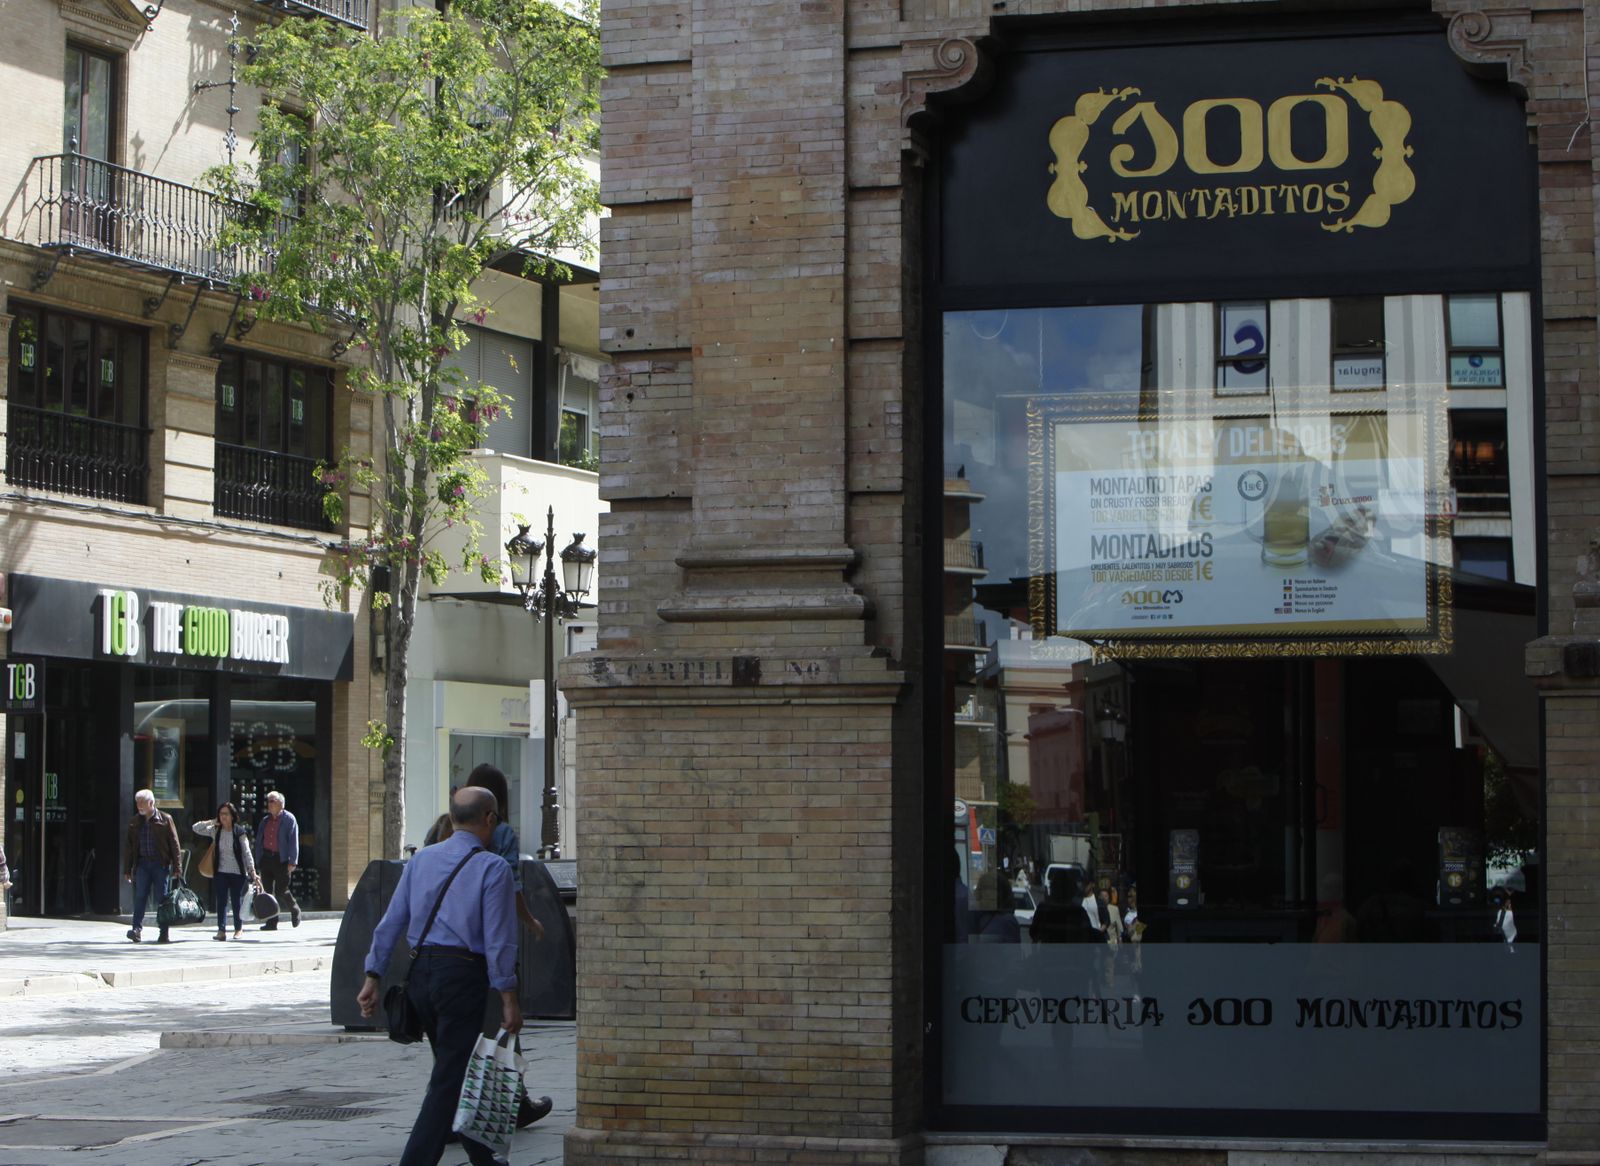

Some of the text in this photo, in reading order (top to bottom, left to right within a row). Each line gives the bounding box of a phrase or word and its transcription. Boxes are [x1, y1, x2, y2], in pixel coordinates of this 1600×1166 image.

[1109, 180, 1351, 223] MONTADITOS
[20, 342, 35, 368] TGB
[1127, 424, 1347, 461] TOTALLY DELICIOUS
[1090, 475, 1213, 496] MONTADITO TAPAS
[1090, 495, 1188, 510] ON CRUSTY FRESH BREAD
[1090, 531, 1214, 560] MONTADITOS
[1091, 560, 1214, 583] 100 VARIEDADES DESDE 1€
[102, 588, 290, 665] TGB THE GOOD BURGER
[6, 662, 36, 701] TGB
[959, 995, 1165, 1031] CERVECERIA
[1296, 997, 1524, 1031] MONTADITOS
